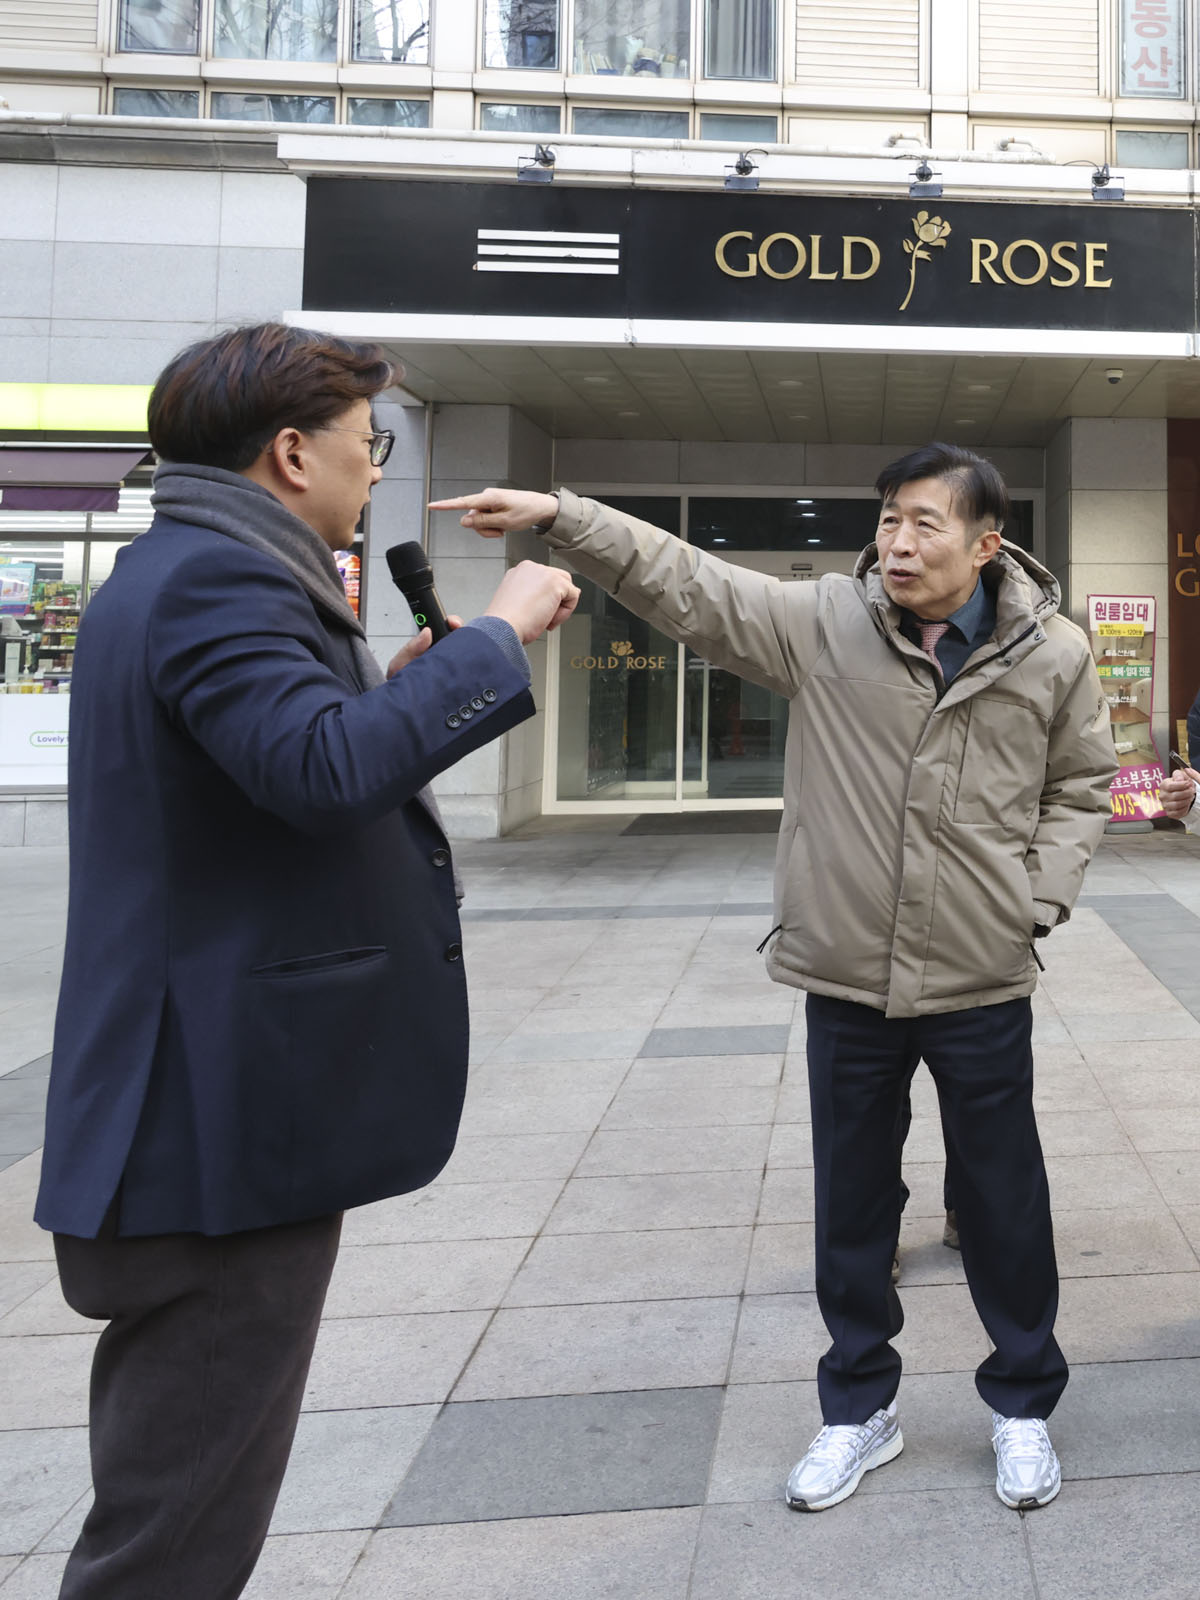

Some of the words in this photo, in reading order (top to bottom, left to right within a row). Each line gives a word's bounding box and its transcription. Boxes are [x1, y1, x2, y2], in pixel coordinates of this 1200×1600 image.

[714, 231, 881, 280] GOLD
[969, 238, 1113, 288] ROSE
[1095, 601, 1148, 621] 원룸임대
[570, 655, 619, 669] GOLD
[626, 655, 667, 670] ROSE
[37, 736, 65, 744] Lovely
